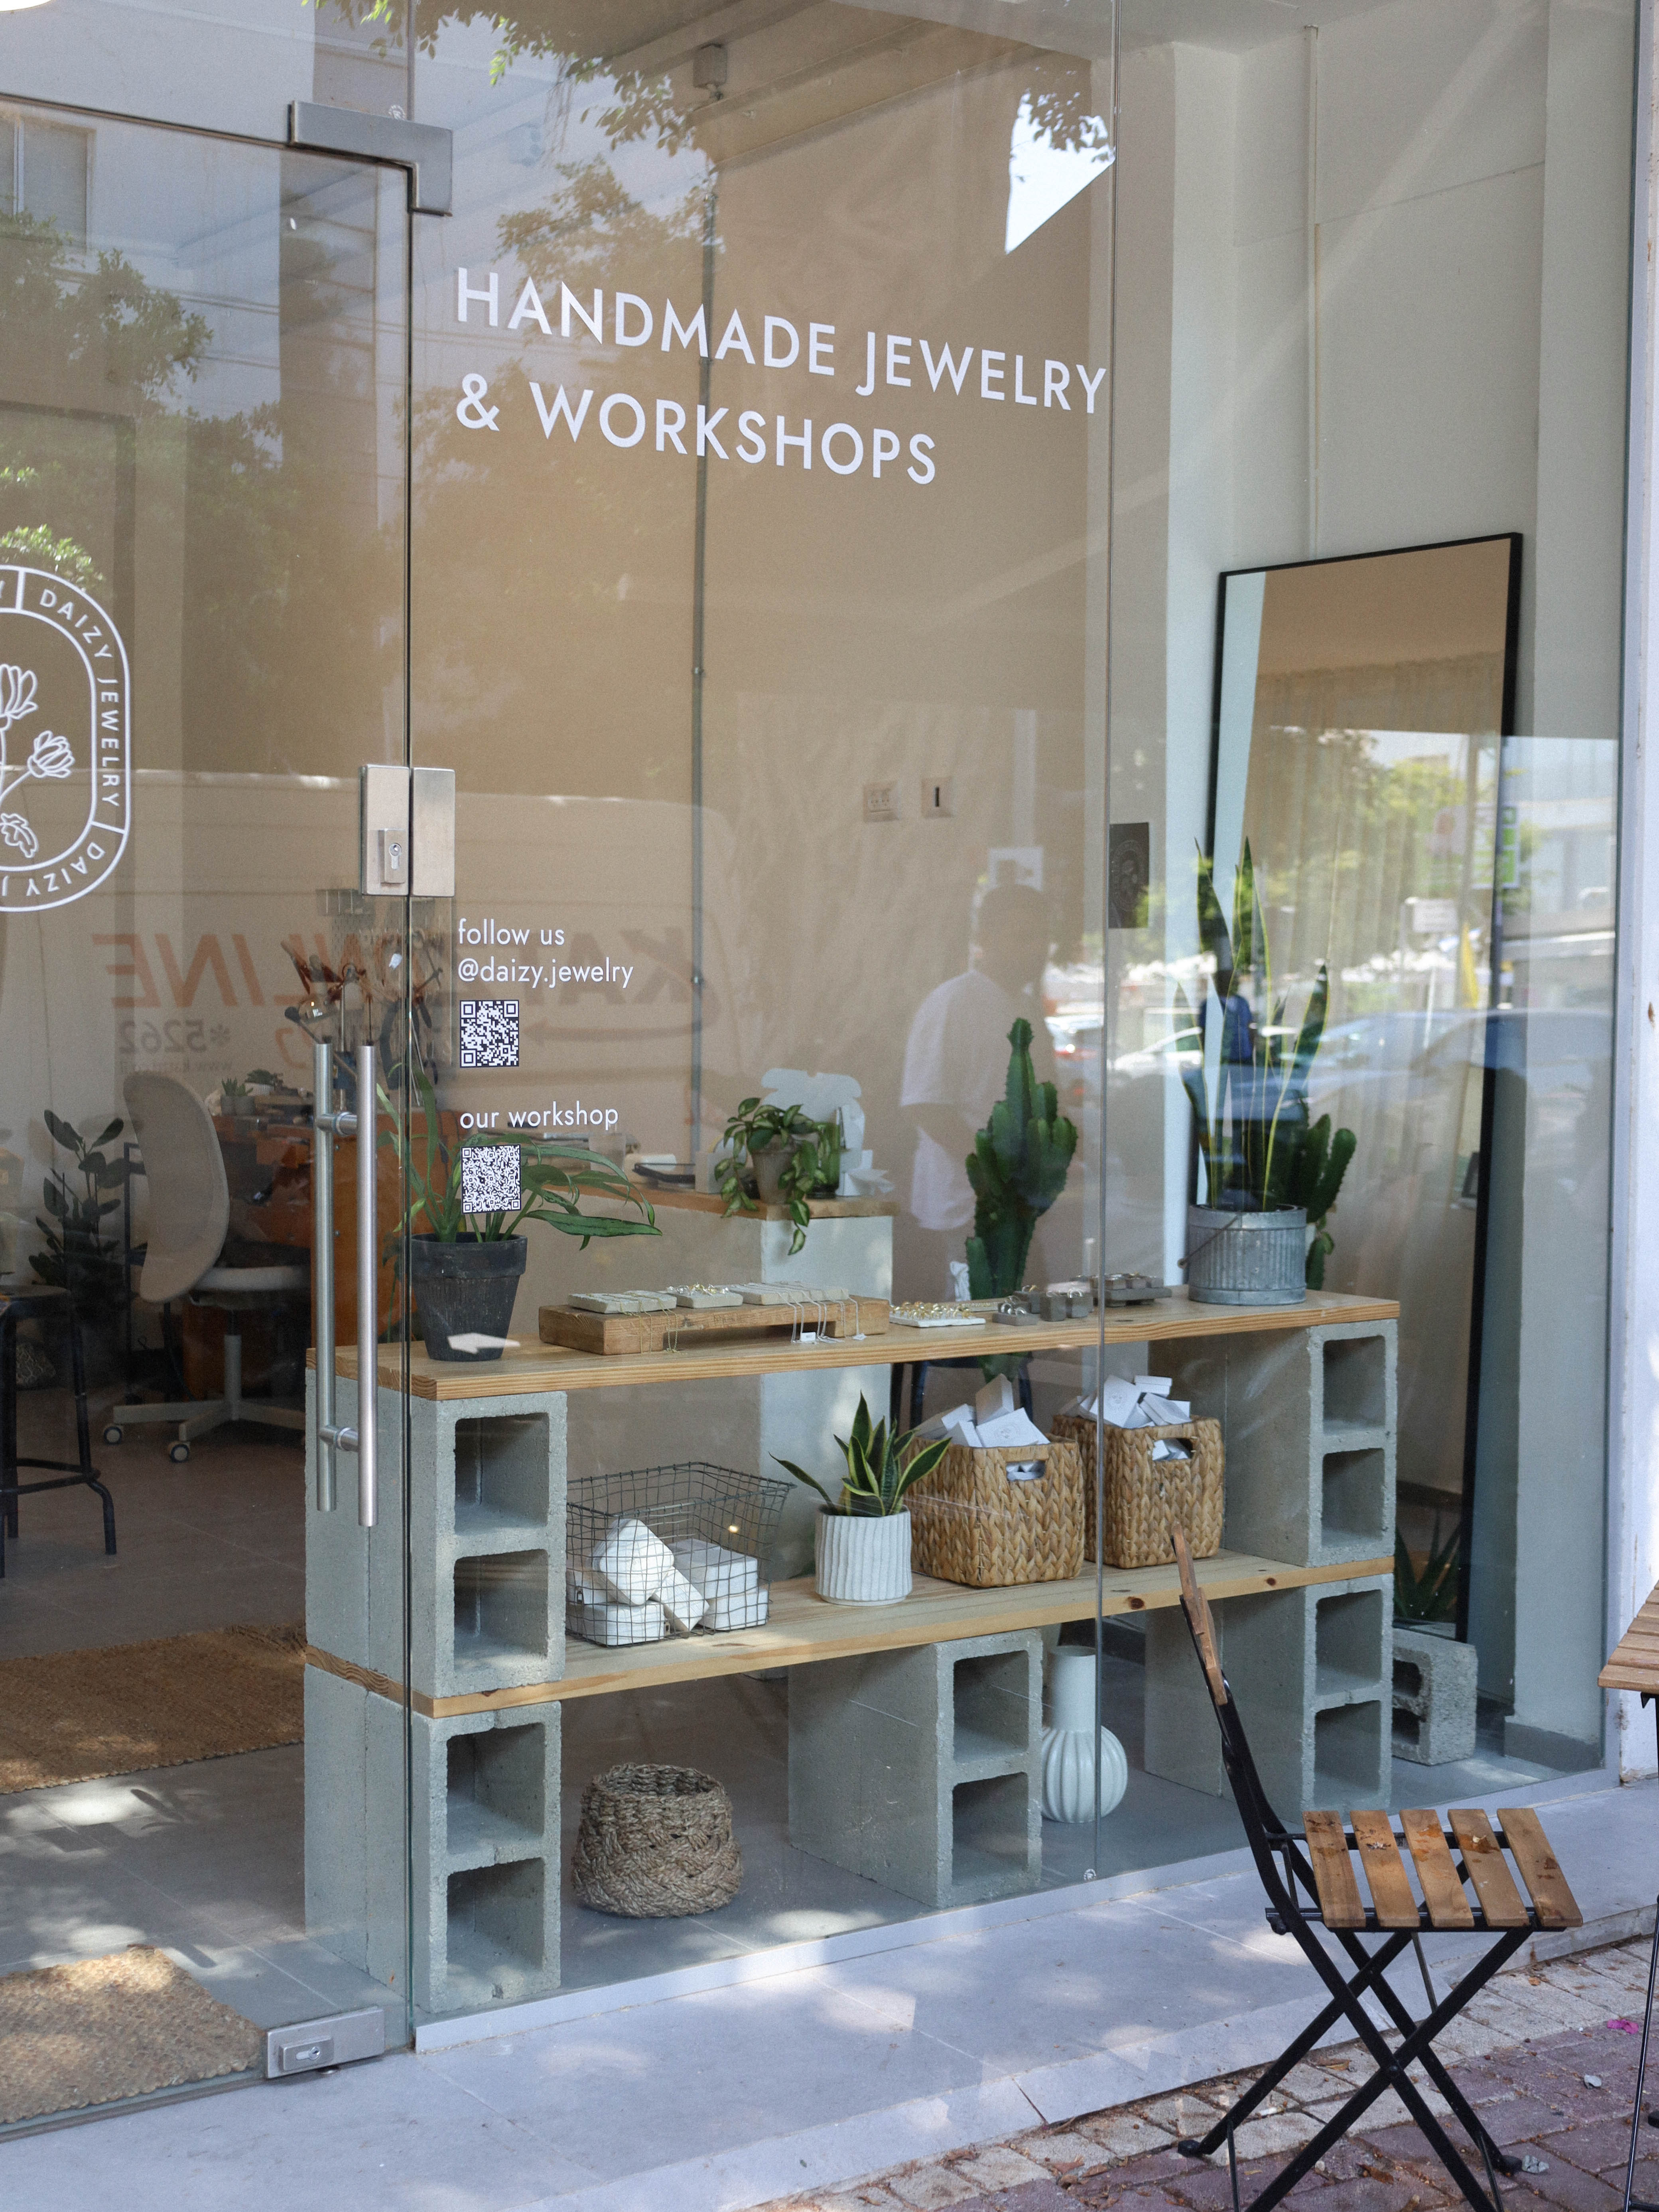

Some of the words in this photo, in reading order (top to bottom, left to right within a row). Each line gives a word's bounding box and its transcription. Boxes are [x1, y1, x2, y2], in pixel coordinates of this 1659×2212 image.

[458, 266, 835, 376] HANDMADE
[855, 331, 1107, 414] JEWELRY
[456, 373, 500, 432] &
[529, 382, 936, 485] WORKSHOPS
[40, 588, 113, 660] DAIZY
[97, 678, 120, 807] JEWELRY
[26, 842, 105, 897] DAIZY
[458, 918, 530, 945] follow
[540, 929, 565, 945] us
[458, 956, 634, 989] @daizy.jewelry
[459, 1111, 500, 1129] our
[508, 1100, 619, 1131] workshop
